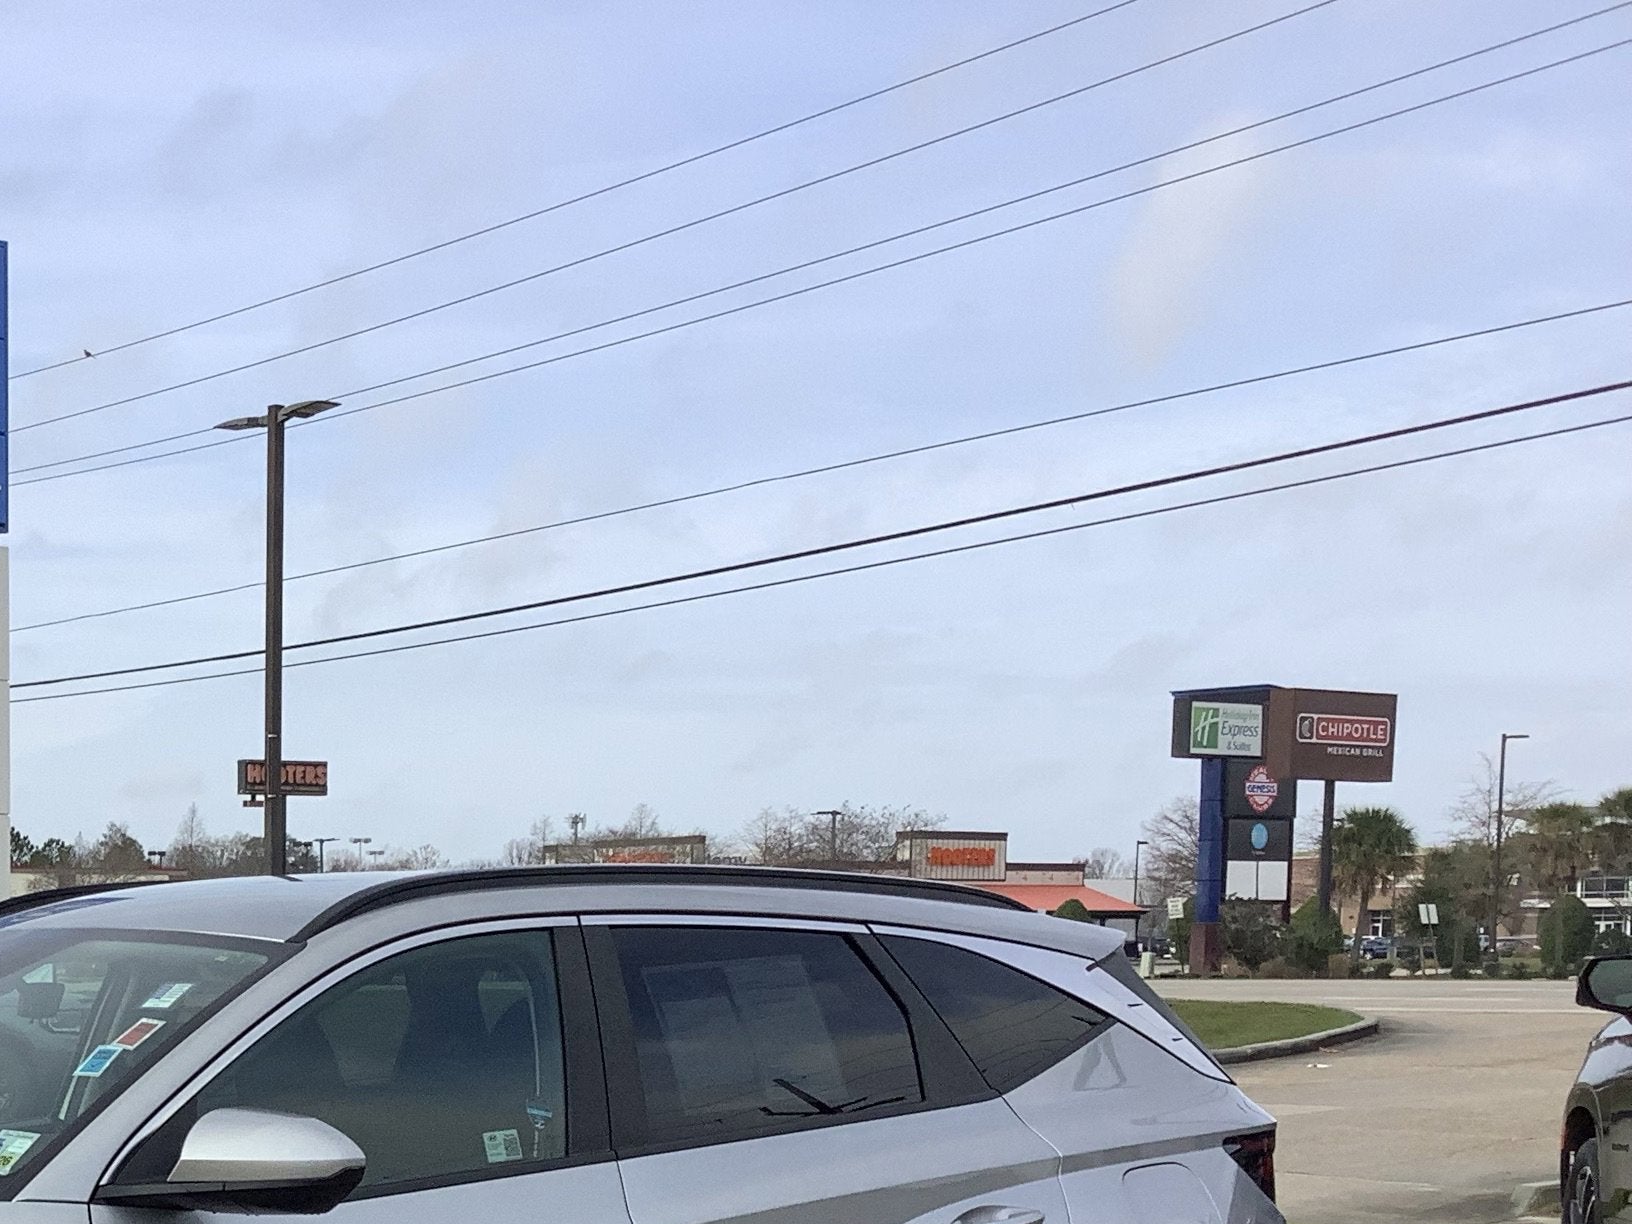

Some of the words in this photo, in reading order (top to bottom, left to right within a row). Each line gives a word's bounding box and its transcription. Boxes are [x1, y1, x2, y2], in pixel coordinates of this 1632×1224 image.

[1221, 720, 1260, 739] Express
[1318, 721, 1386, 739] CHIPOTLE
[1327, 746, 1361, 756] MEXICAN
[1362, 748, 1384, 757] GRILL
[247, 763, 327, 785] HTERS
[1247, 784, 1276, 794] GENESIS
